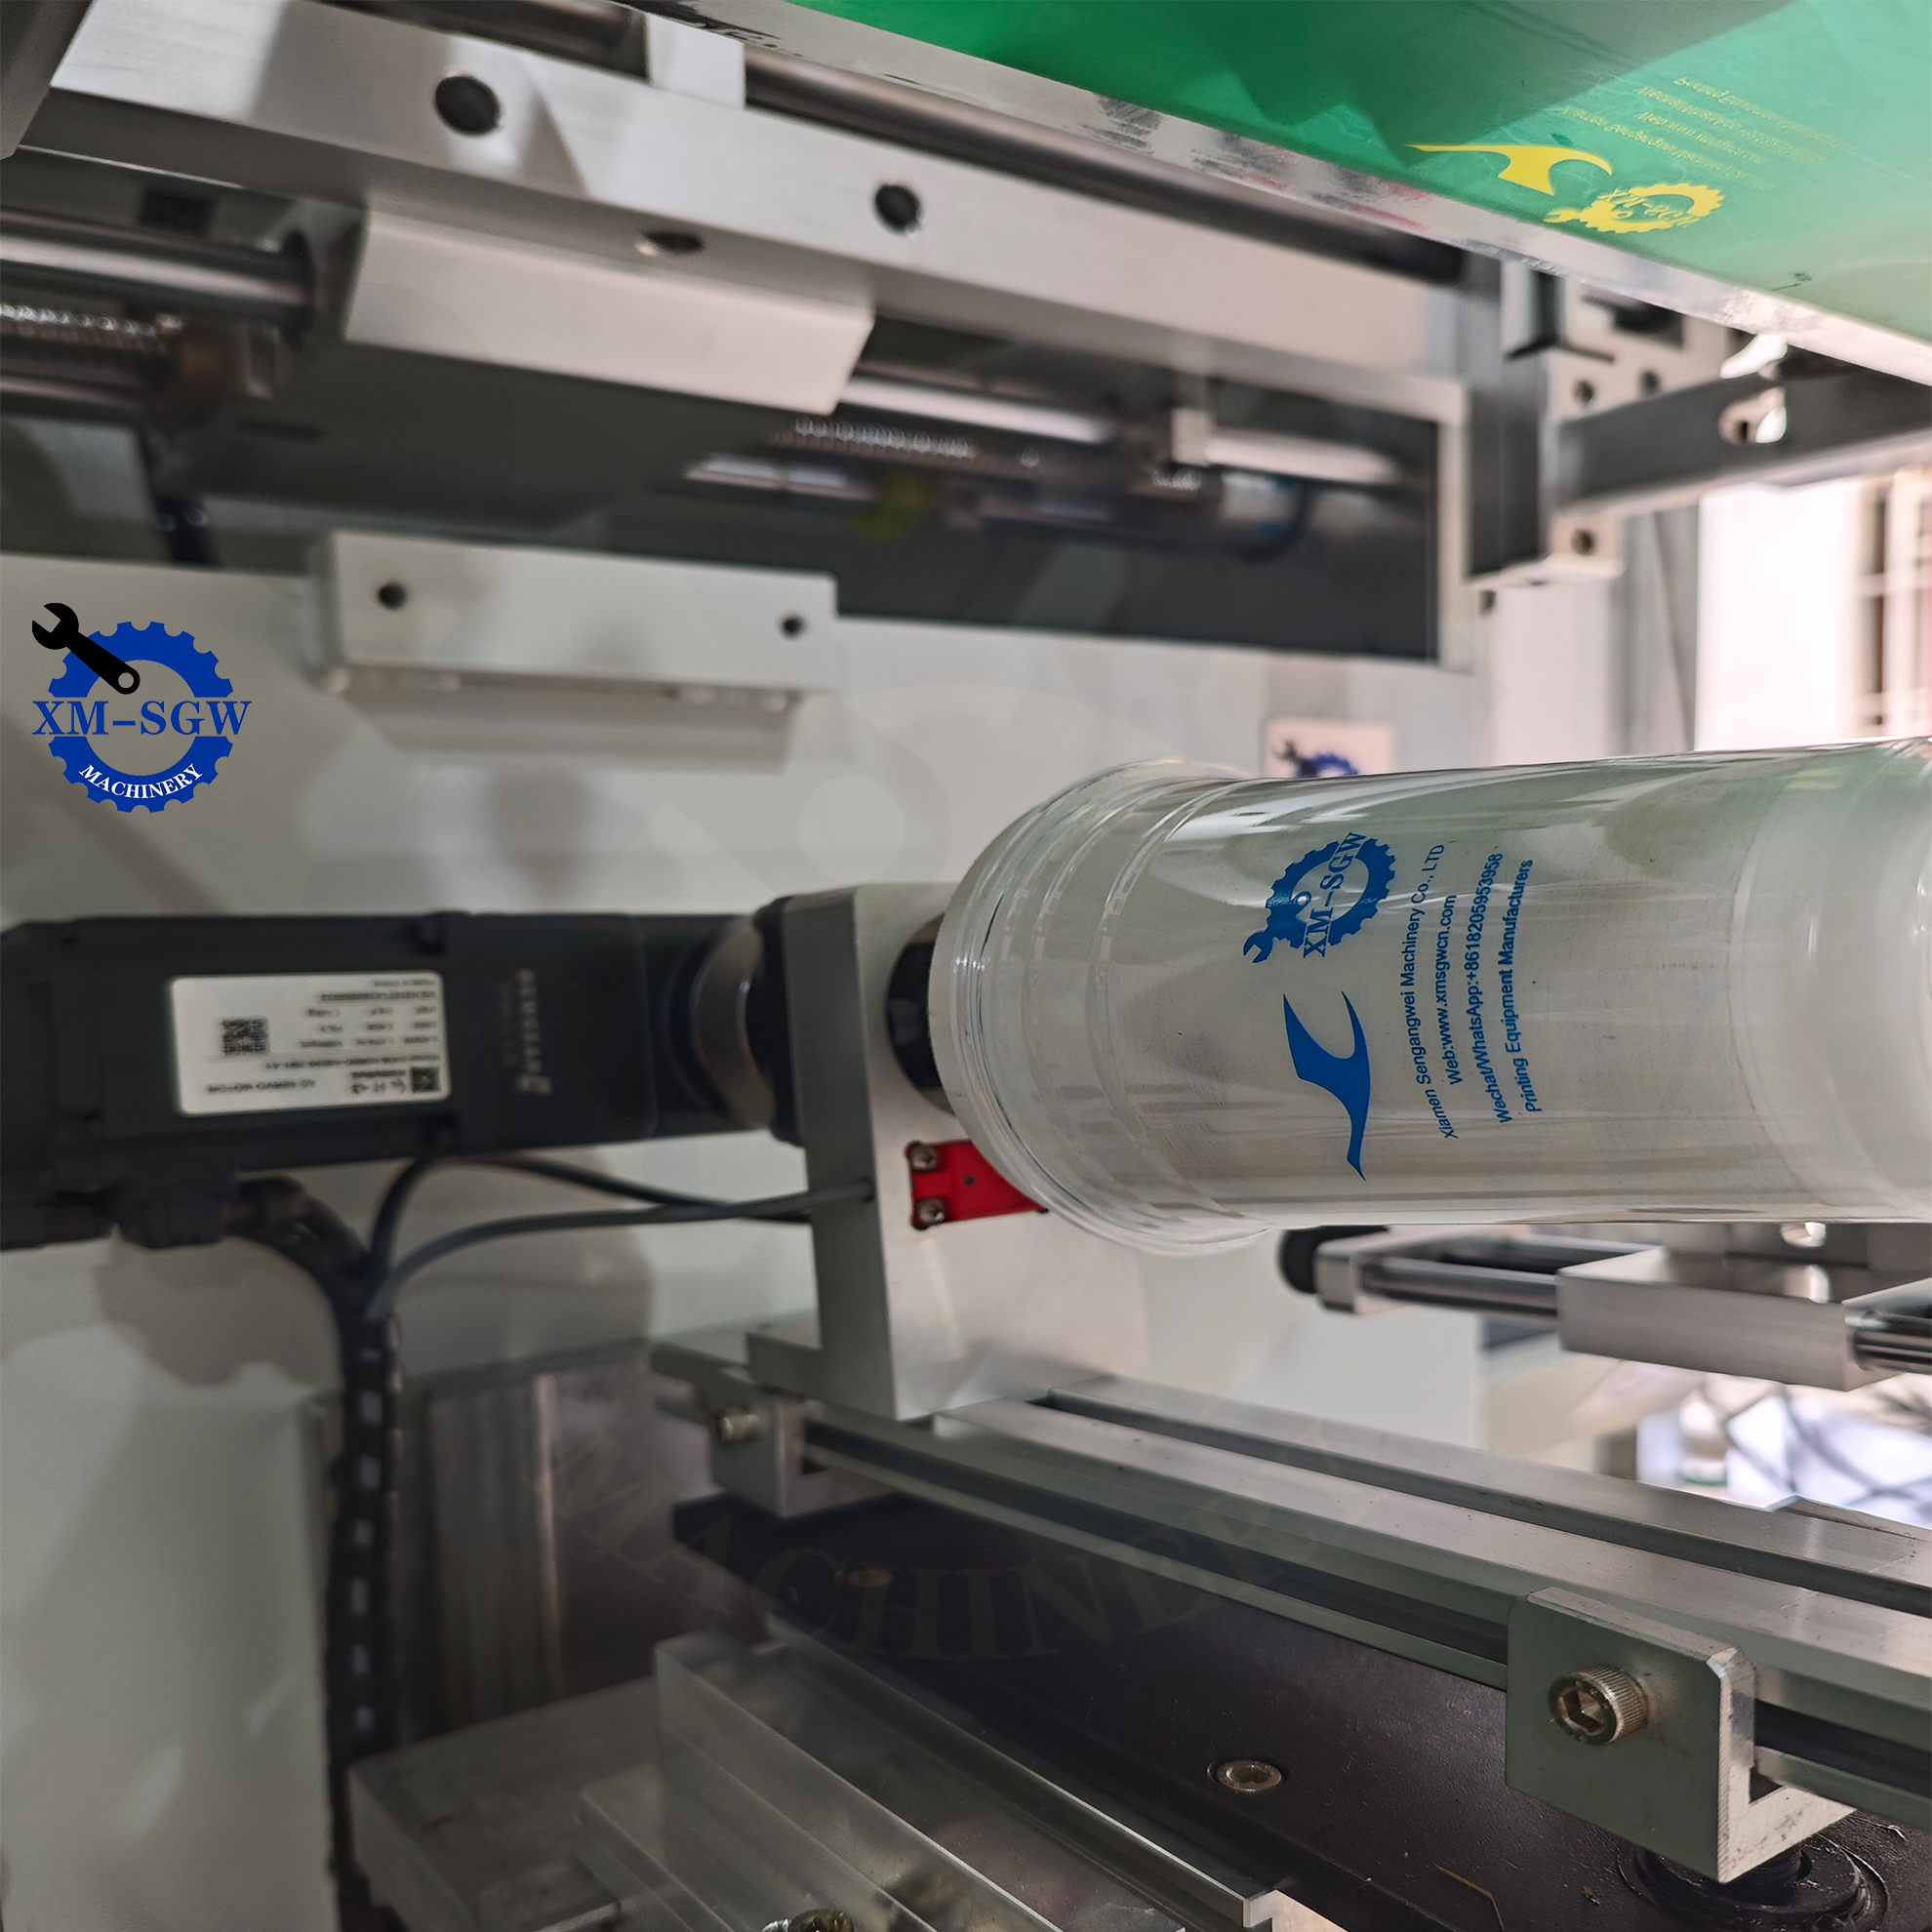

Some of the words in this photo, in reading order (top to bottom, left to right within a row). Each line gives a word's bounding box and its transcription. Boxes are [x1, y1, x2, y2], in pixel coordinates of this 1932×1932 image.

[1303, 831, 1367, 958] XM-SGW
[1411, 875, 1435, 905] Co.,
[1421, 843, 1445, 873] LTD
[1399, 906, 1427, 987] Machinery
[1497, 860, 1534, 966] Manufacturers
[1434, 894, 1464, 1086] Web:www.xmsgwcn.com
[1499, 969, 1522, 1054] Equipment
[1400, 991, 1431, 1085] Sengangwei
[1427, 1088, 1460, 1140] Xiamen
[1512, 1058, 1543, 1113] Printing
